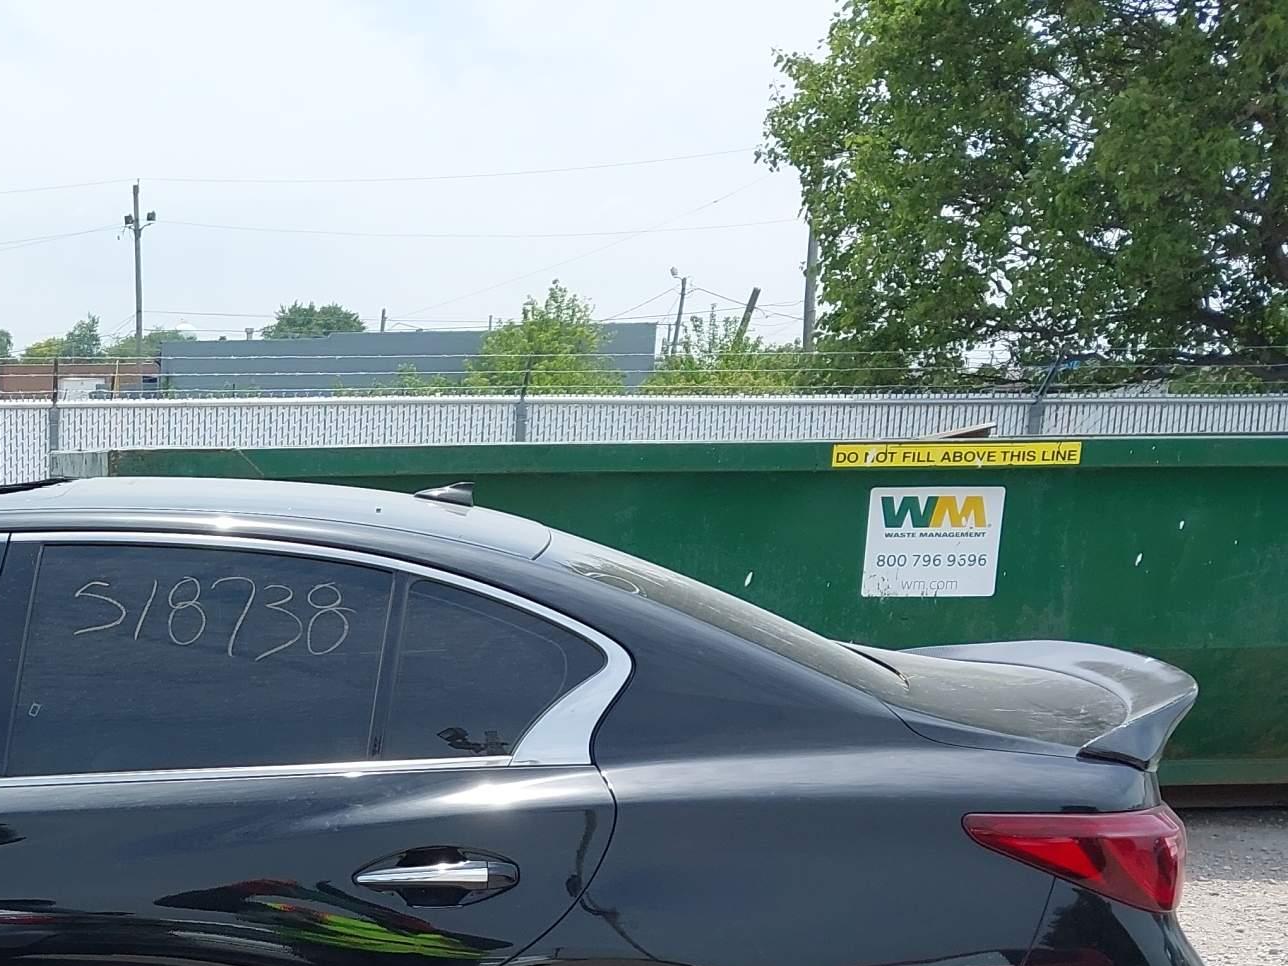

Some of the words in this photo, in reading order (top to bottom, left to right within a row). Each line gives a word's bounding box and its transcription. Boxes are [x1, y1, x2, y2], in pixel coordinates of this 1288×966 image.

[835, 451, 859, 464] DO
[864, 451, 897, 463] NOT
[902, 451, 935, 463] FILL
[940, 450, 996, 463] ABOVE
[1001, 450, 1036, 462] THIS
[1042, 449, 1078, 462] LINE
[880, 496, 987, 528] WM
[876, 554, 907, 567] 800
[912, 554, 942, 567] 796
[901, 580, 958, 590] wm.com
[73, 576, 357, 662] 518738
